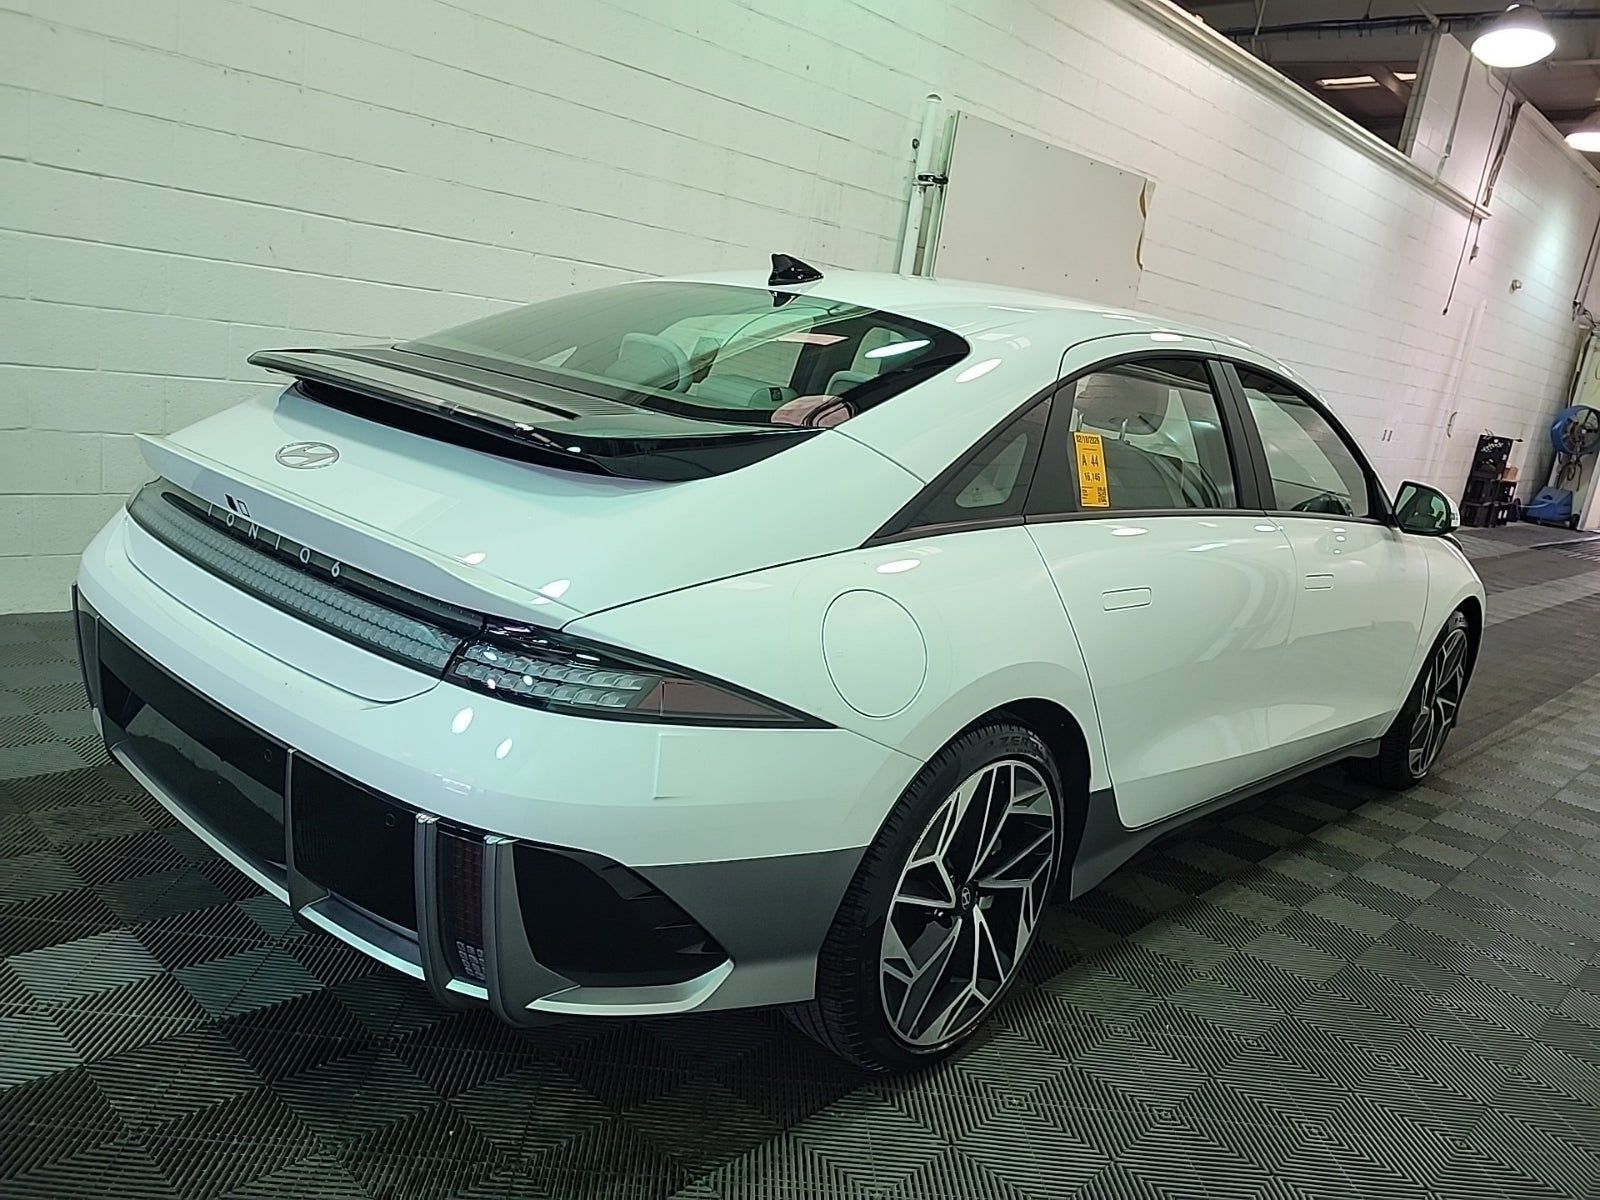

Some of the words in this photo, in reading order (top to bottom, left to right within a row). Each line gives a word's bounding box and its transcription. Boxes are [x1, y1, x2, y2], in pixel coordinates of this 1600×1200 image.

[1082, 453, 1087, 466] A
[1091, 454, 1099, 467] 44
[207, 503, 311, 564] IONIQ
[331, 561, 341, 578] 6
